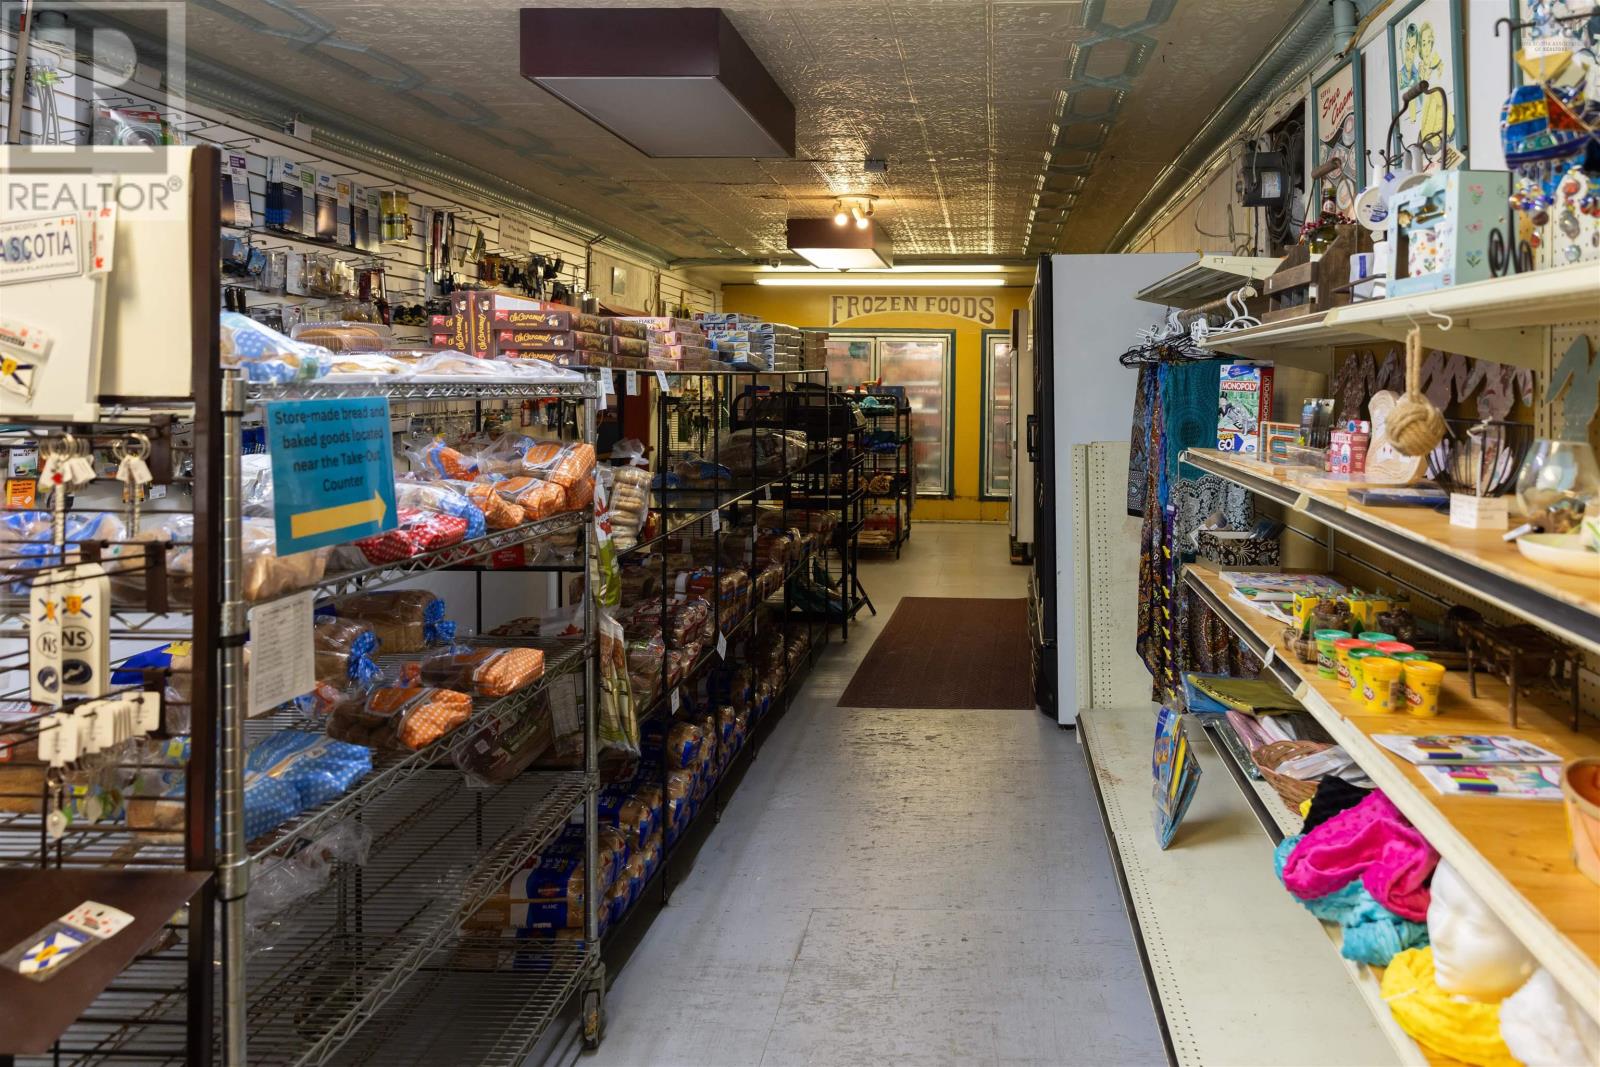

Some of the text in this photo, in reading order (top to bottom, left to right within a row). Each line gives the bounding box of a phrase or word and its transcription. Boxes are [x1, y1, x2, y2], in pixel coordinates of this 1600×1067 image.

[10, 230, 73, 262] SCOTIA
[831, 295, 995, 326] FROZEN FOODS
[1221, 382, 1257, 391] MONOPOLY
[1263, 377, 1271, 421] MONOPOLY
[274, 406, 385, 425] Store-made bread and
[282, 429, 384, 449] baked goods located
[1217, 438, 1235, 452] GO!
[293, 451, 381, 472] near the Take-Out
[322, 475, 364, 492] Counter
[61, 630, 87, 648] NS
